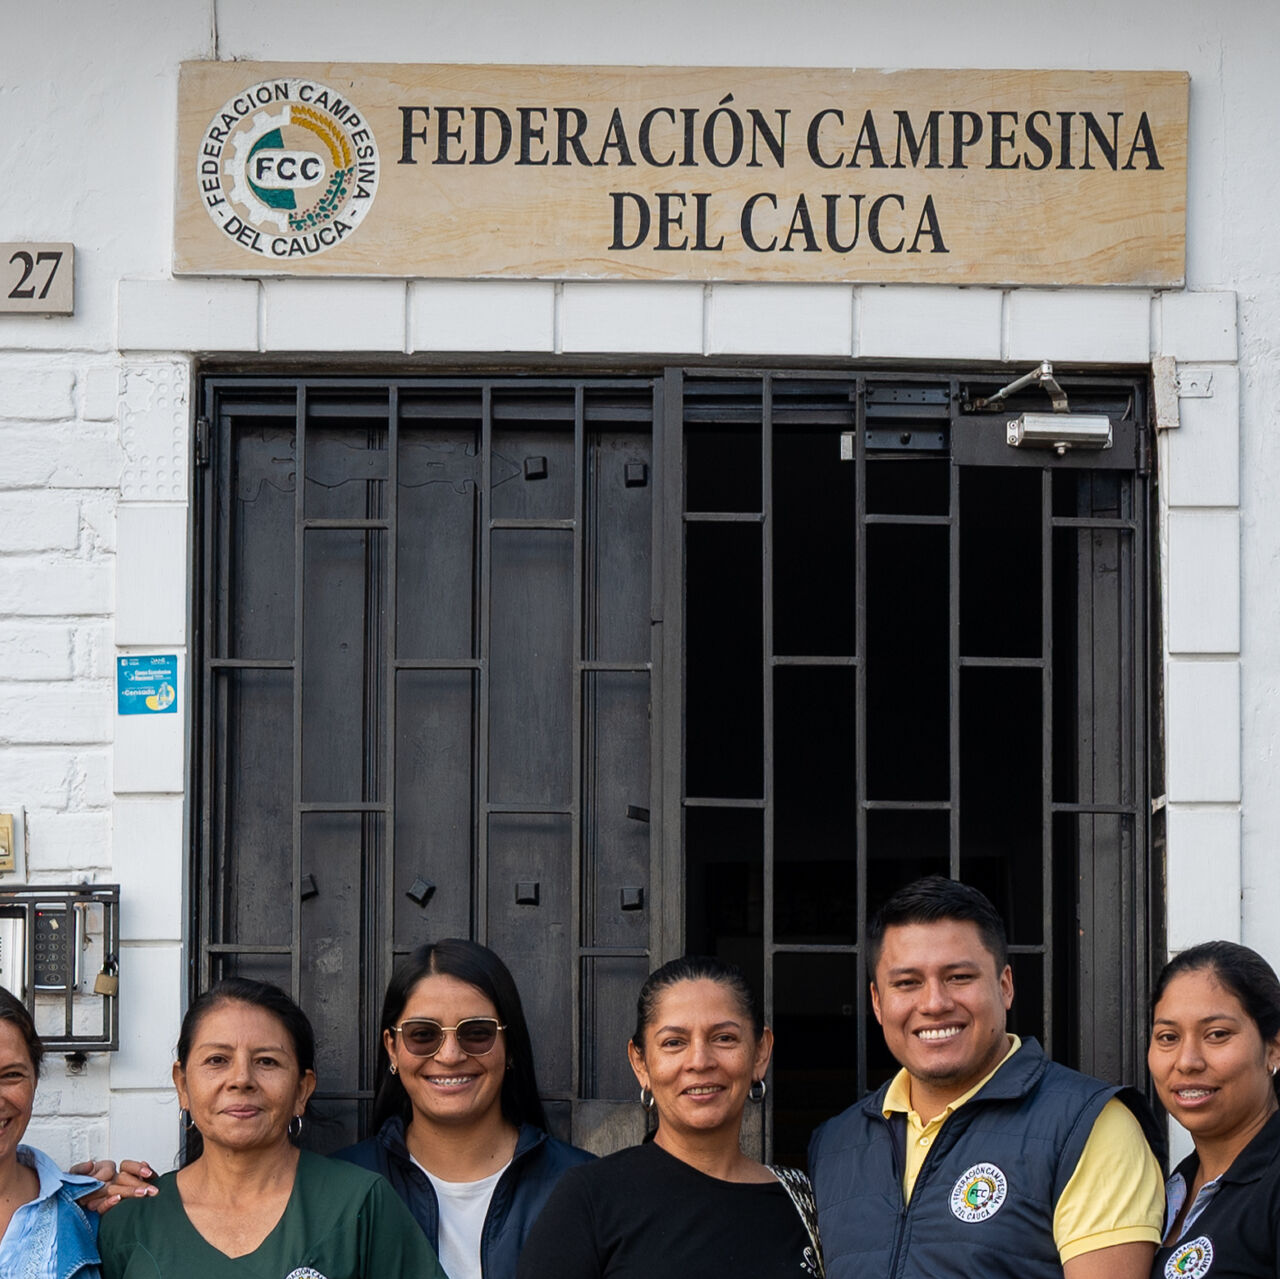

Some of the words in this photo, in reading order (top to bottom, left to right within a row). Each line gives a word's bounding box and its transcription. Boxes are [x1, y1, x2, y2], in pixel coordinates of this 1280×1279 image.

[299, 85, 375, 199] CAMPESINA
[397, 93, 788, 168] FEDERACIÓN
[807, 109, 1163, 172] CAMPESINA
[256, 157, 320, 181] FCC
[223, 216, 264, 253] DEL
[271, 219, 352, 257] CAUCA
[607, 191, 725, 253] DEL
[739, 192, 949, 256] CAUCA
[967, 1209, 990, 1220] CAUCA
